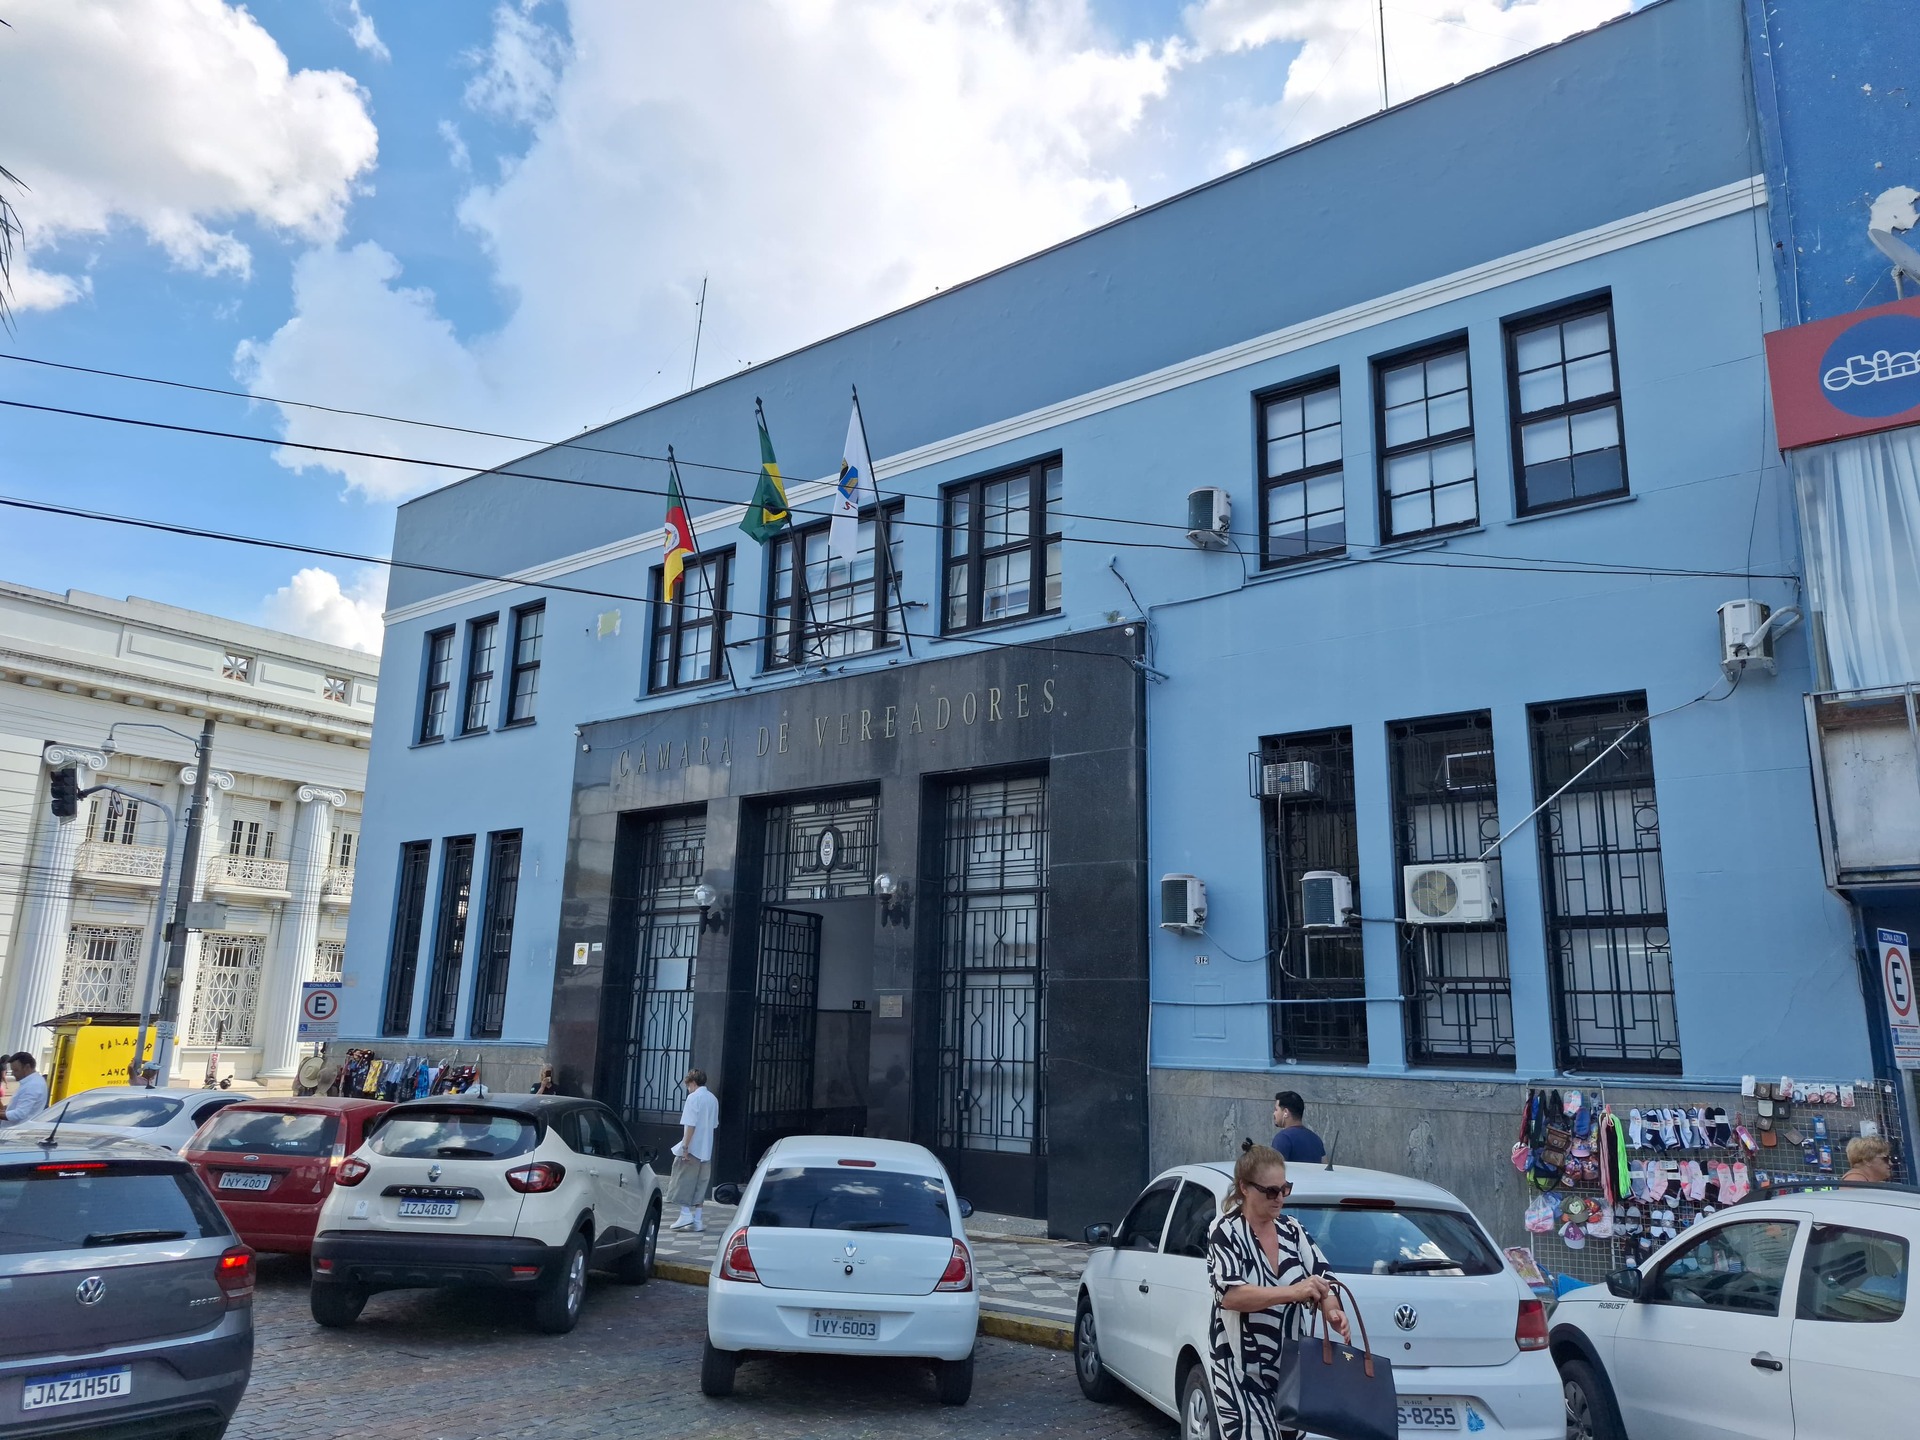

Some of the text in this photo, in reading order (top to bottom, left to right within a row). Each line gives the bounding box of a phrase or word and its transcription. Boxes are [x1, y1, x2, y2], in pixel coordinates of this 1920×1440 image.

[619, 678, 1057, 778] CÂMARA DE VEREADORES
[1882, 932, 1893, 942] ZONA
[1891, 961, 1905, 1002] E
[314, 996, 327, 1014] E
[222, 1177, 267, 1189] INY 4001
[398, 1187, 465, 1197] CAPTUR
[403, 1203, 453, 1216] IZJ4B03
[1598, 1302, 1626, 1310] ROBUST
[33, 1374, 121, 1405] JAZ1H50
